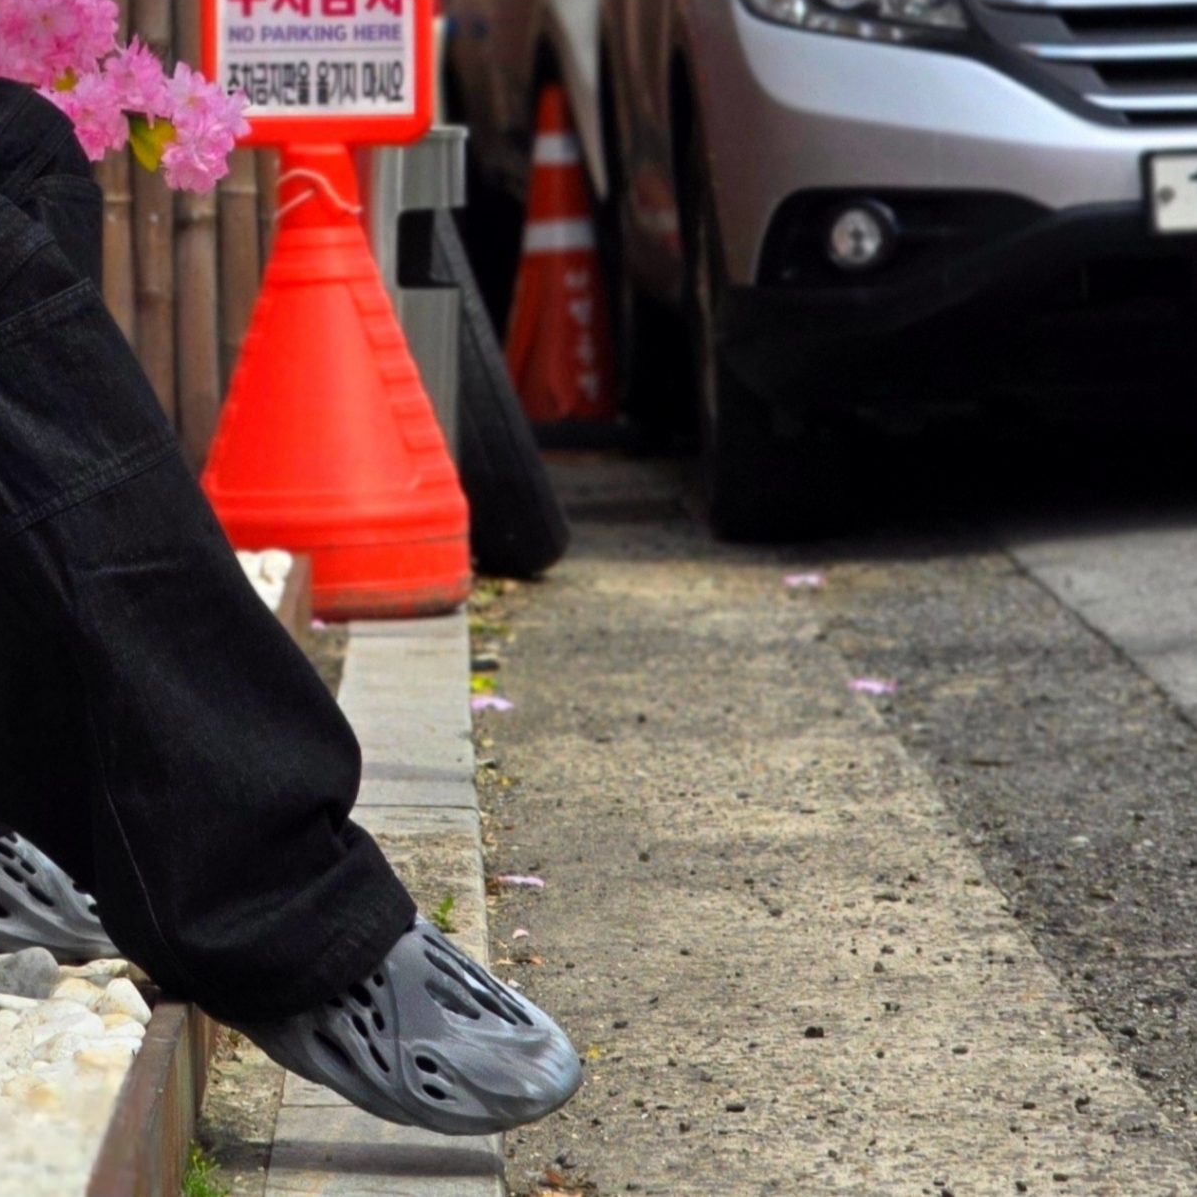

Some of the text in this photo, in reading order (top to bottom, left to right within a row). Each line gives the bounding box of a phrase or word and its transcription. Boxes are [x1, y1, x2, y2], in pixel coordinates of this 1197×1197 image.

[228, 23, 402, 42] NO PARKING HERE
[363, 60, 405, 102] 마시오
